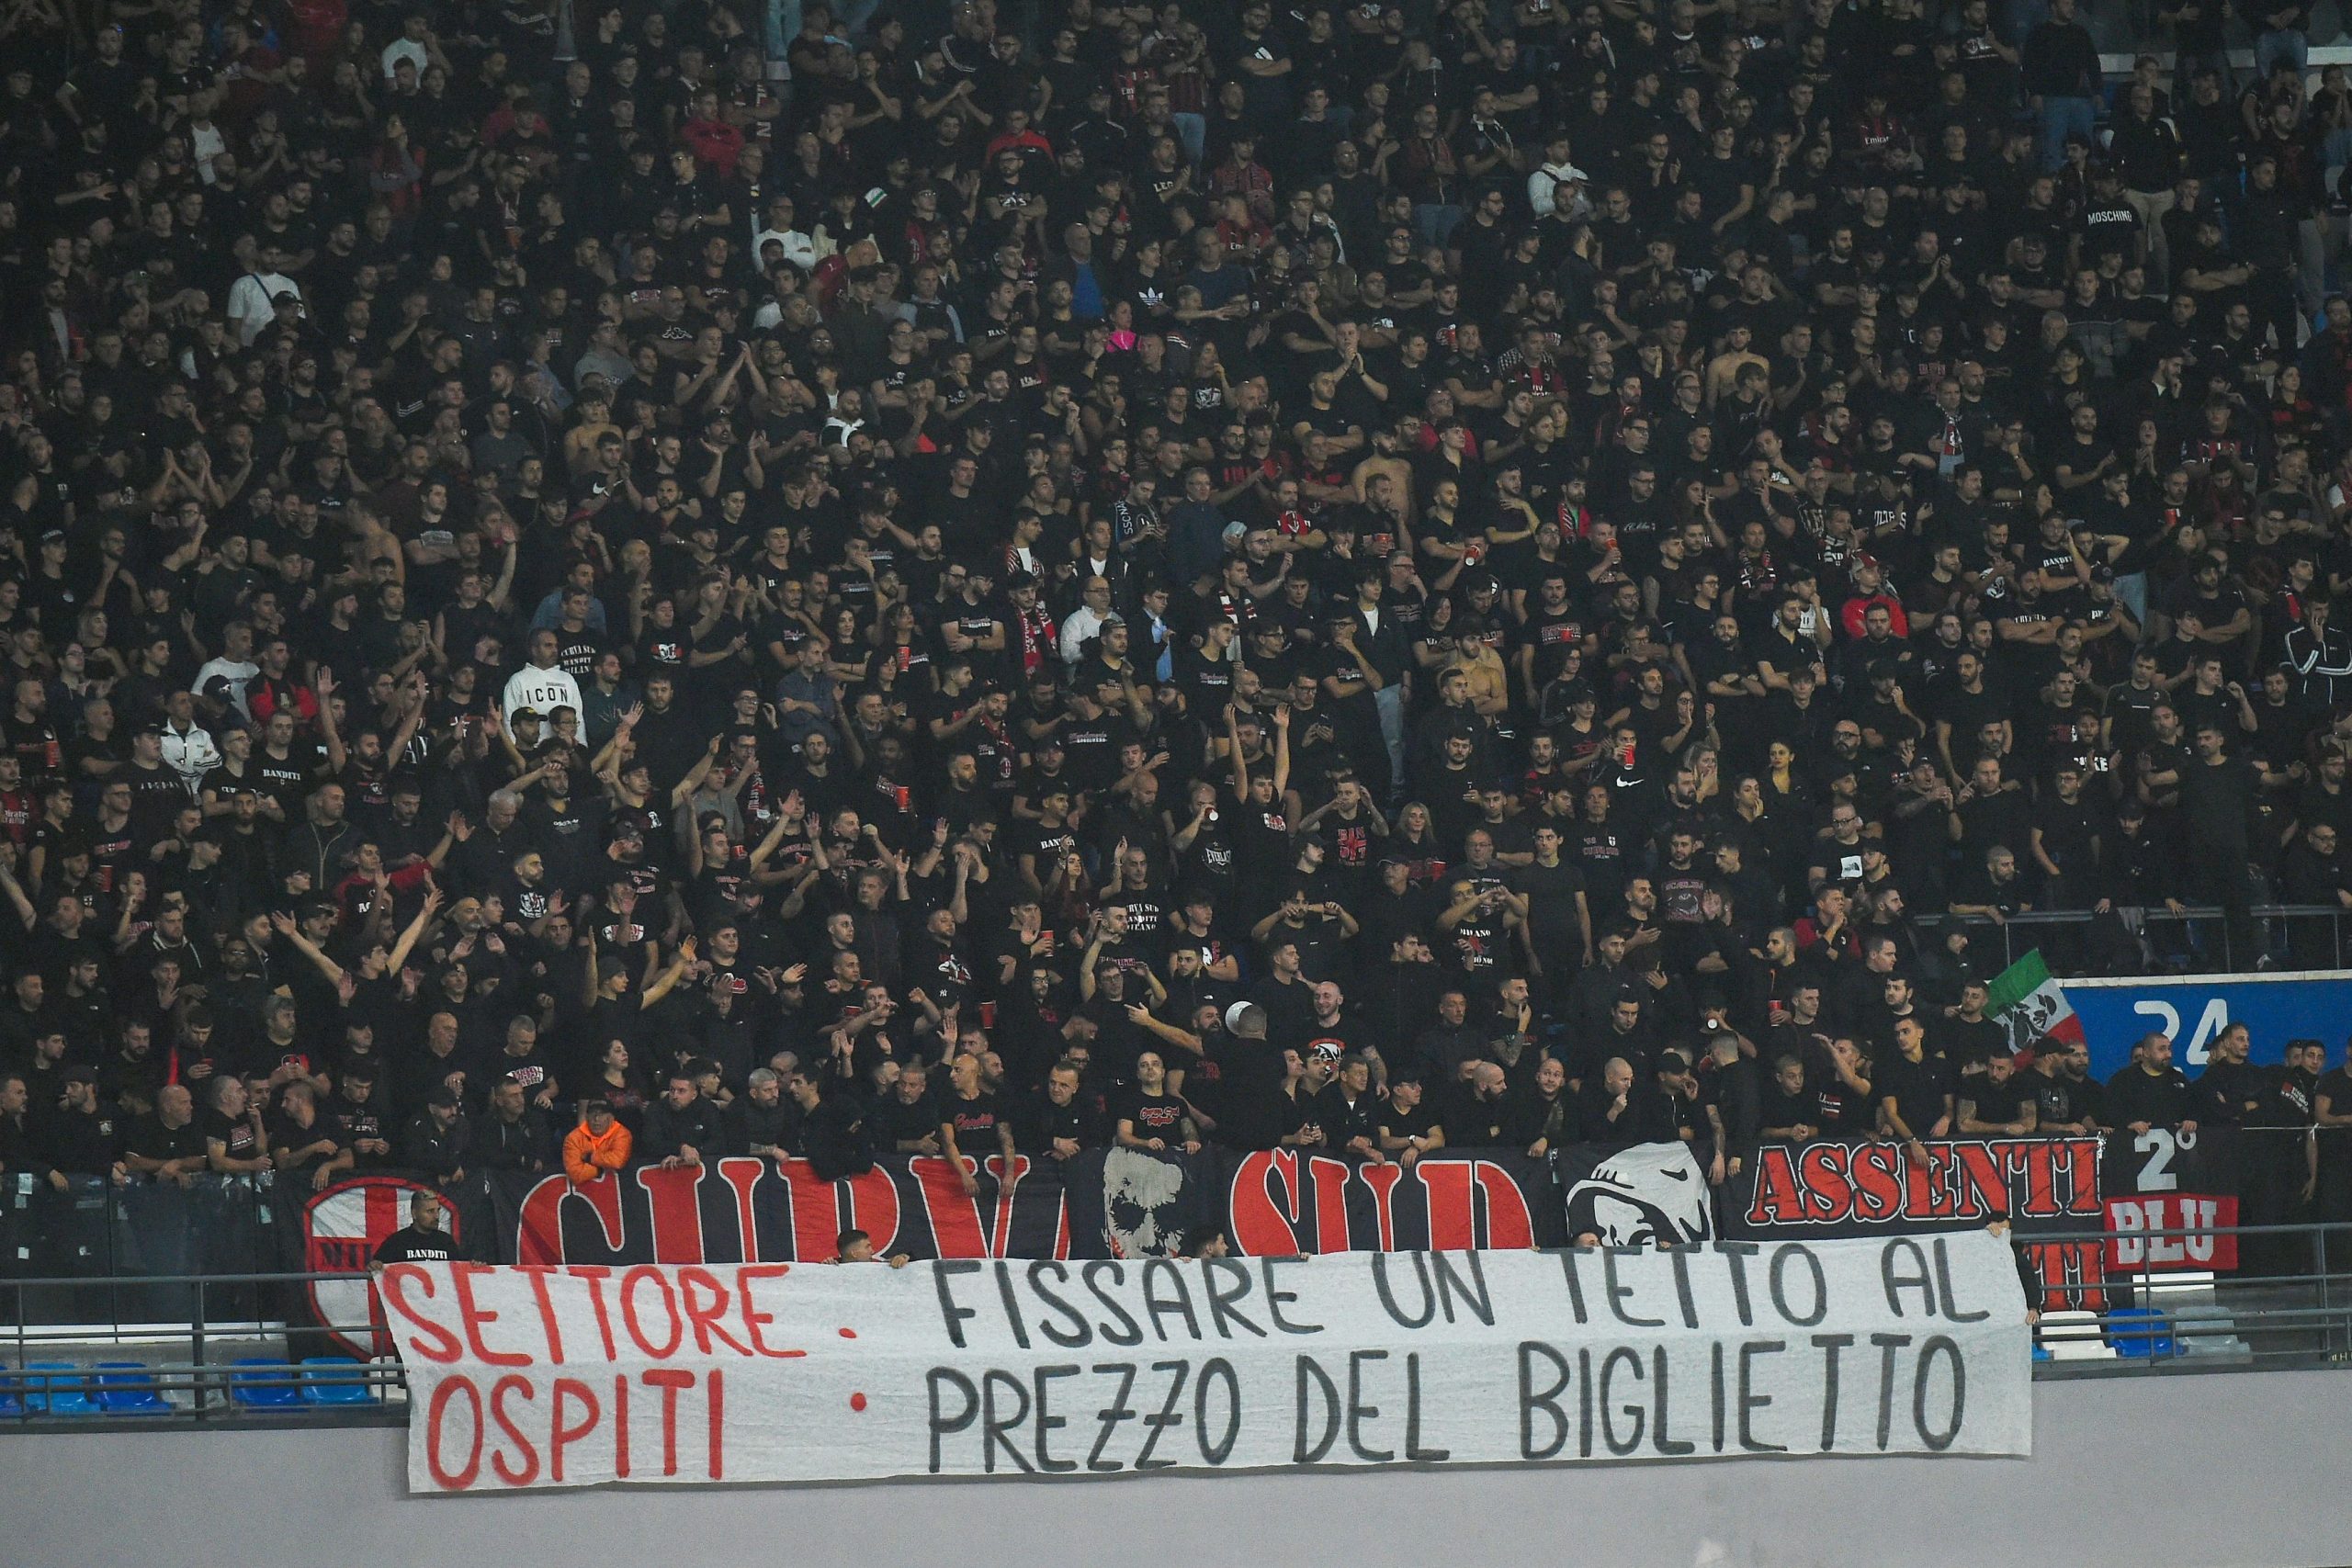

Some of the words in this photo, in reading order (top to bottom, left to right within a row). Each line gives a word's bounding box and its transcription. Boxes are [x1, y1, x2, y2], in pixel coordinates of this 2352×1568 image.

[2086, 209, 2132, 226] MOSCHINO
[1873, 510, 1907, 530] ULTRS
[2042, 555, 2074, 569] BANDIT
[526, 687, 569, 704] ICON
[263, 768, 301, 782] BANDITI
[1126, 915, 1158, 923] ANDITI
[1126, 922, 1157, 932] ILANO
[1746, 1136, 2104, 1227] ASSENTI
[515, 1155, 1072, 1266] CURV
[2110, 1198, 2218, 1266] BLU
[406, 1248, 447, 1259] BANDITI
[382, 1262, 808, 1367] SETTORE
[932, 1255, 1325, 1349] FISSARE
[1373, 1250, 1495, 1329] UN
[1539, 1240, 1828, 1329] TETTO
[1881, 1237, 1991, 1324] AL
[427, 1369, 724, 1491] OSPITI
[925, 1355, 1241, 1474] PREZZO
[1292, 1348, 1451, 1464] DEL
[1518, 1333, 1966, 1461] BIGLIETTO
